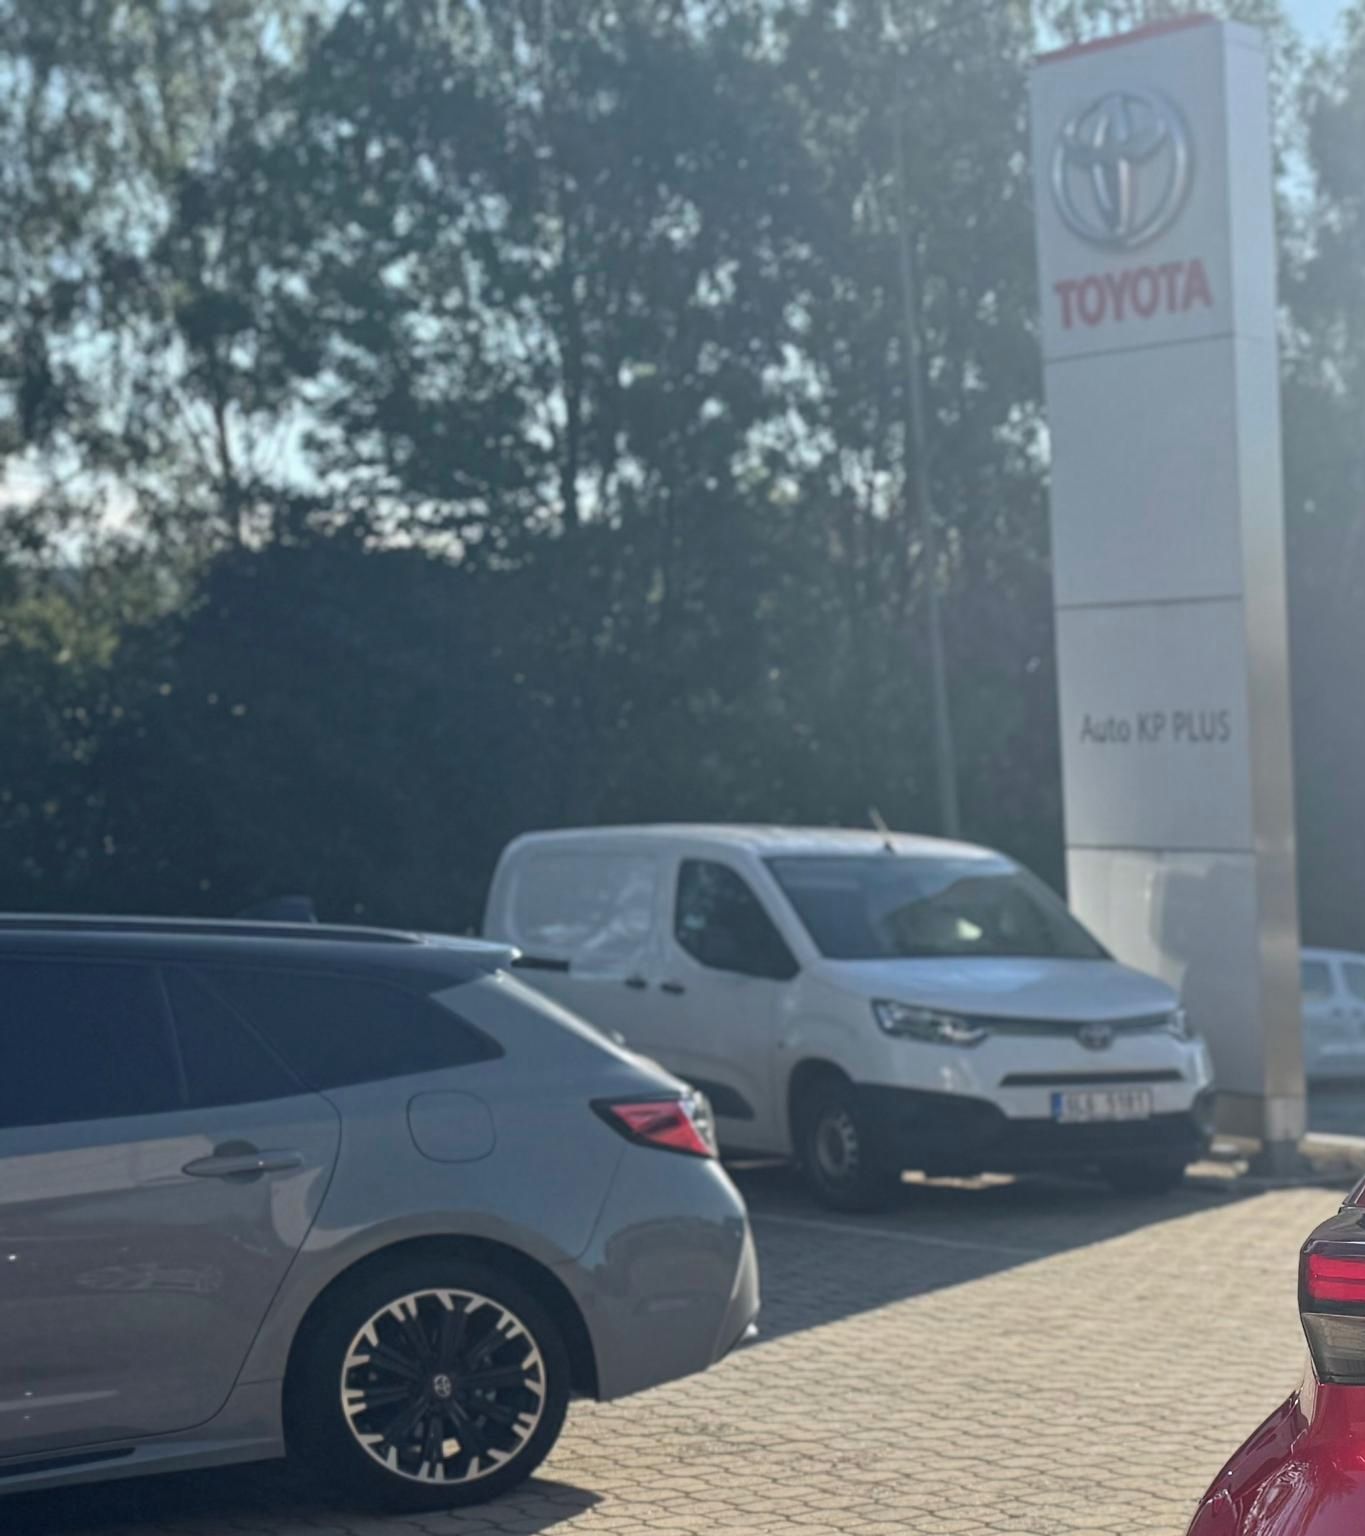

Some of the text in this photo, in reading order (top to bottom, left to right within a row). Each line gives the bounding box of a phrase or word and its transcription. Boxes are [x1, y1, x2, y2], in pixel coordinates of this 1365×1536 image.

[1055, 258, 1214, 330] TOYOTA
[1080, 709, 1231, 744] Auto KP PLUS
